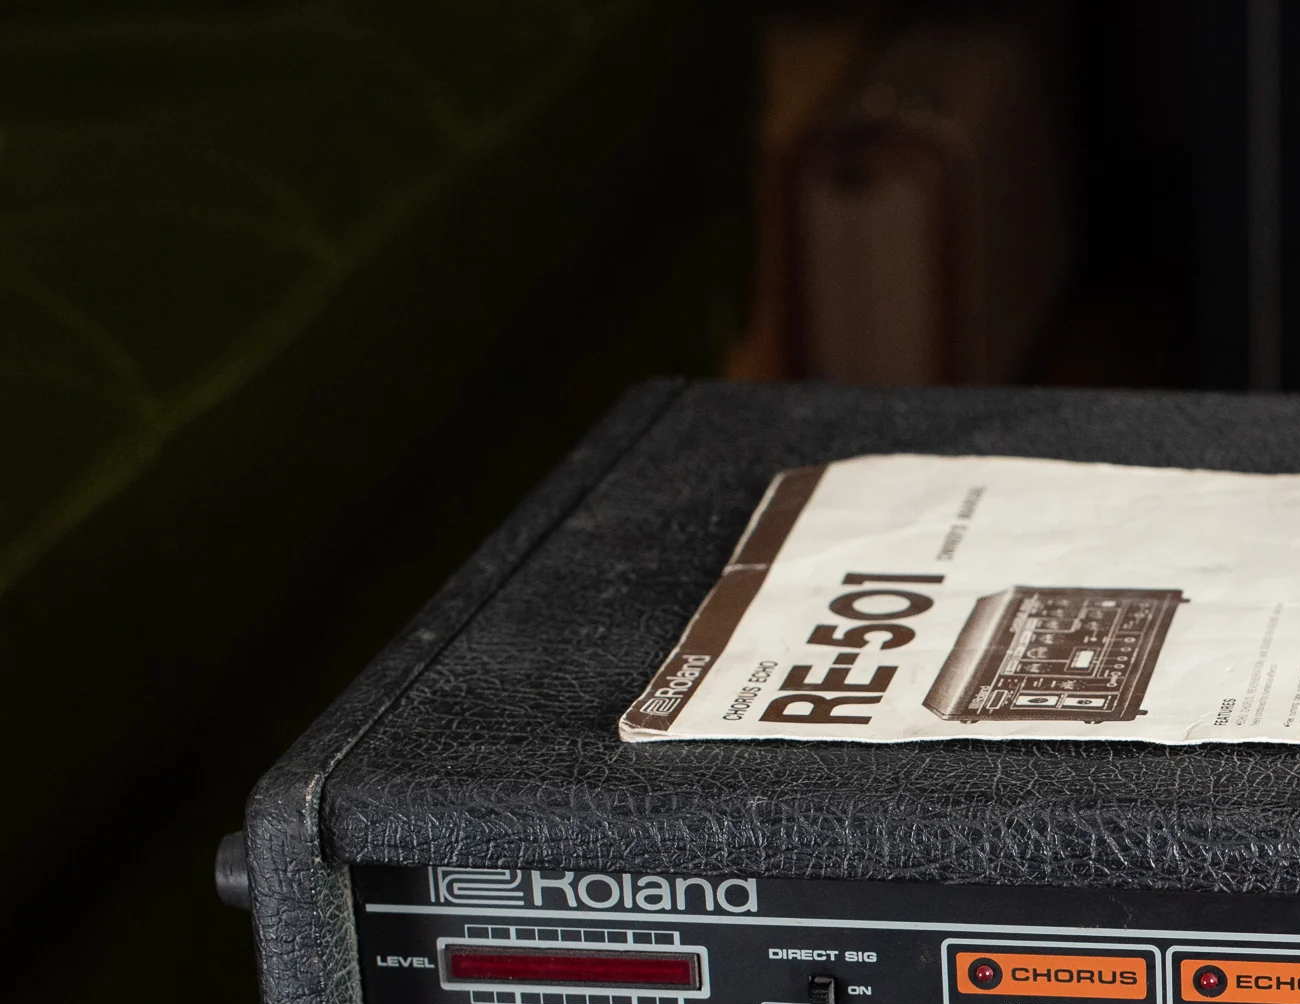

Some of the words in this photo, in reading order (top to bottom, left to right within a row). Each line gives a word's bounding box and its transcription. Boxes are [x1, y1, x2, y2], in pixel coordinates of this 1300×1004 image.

[758, 572, 945, 725] RE-501
[654, 654, 711, 699] Roland
[723, 685, 762, 721] CHORUS
[748, 660, 778, 683] ECHO
[1213, 698, 1236, 725] FEATURES
[531, 870, 758, 913] Roland
[376, 955, 435, 968] LEVEL
[768, 948, 838, 961] DIRECT
[844, 951, 877, 963] SIG
[1011, 966, 1138, 985] CHORUS
[848, 985, 872, 996] ON
